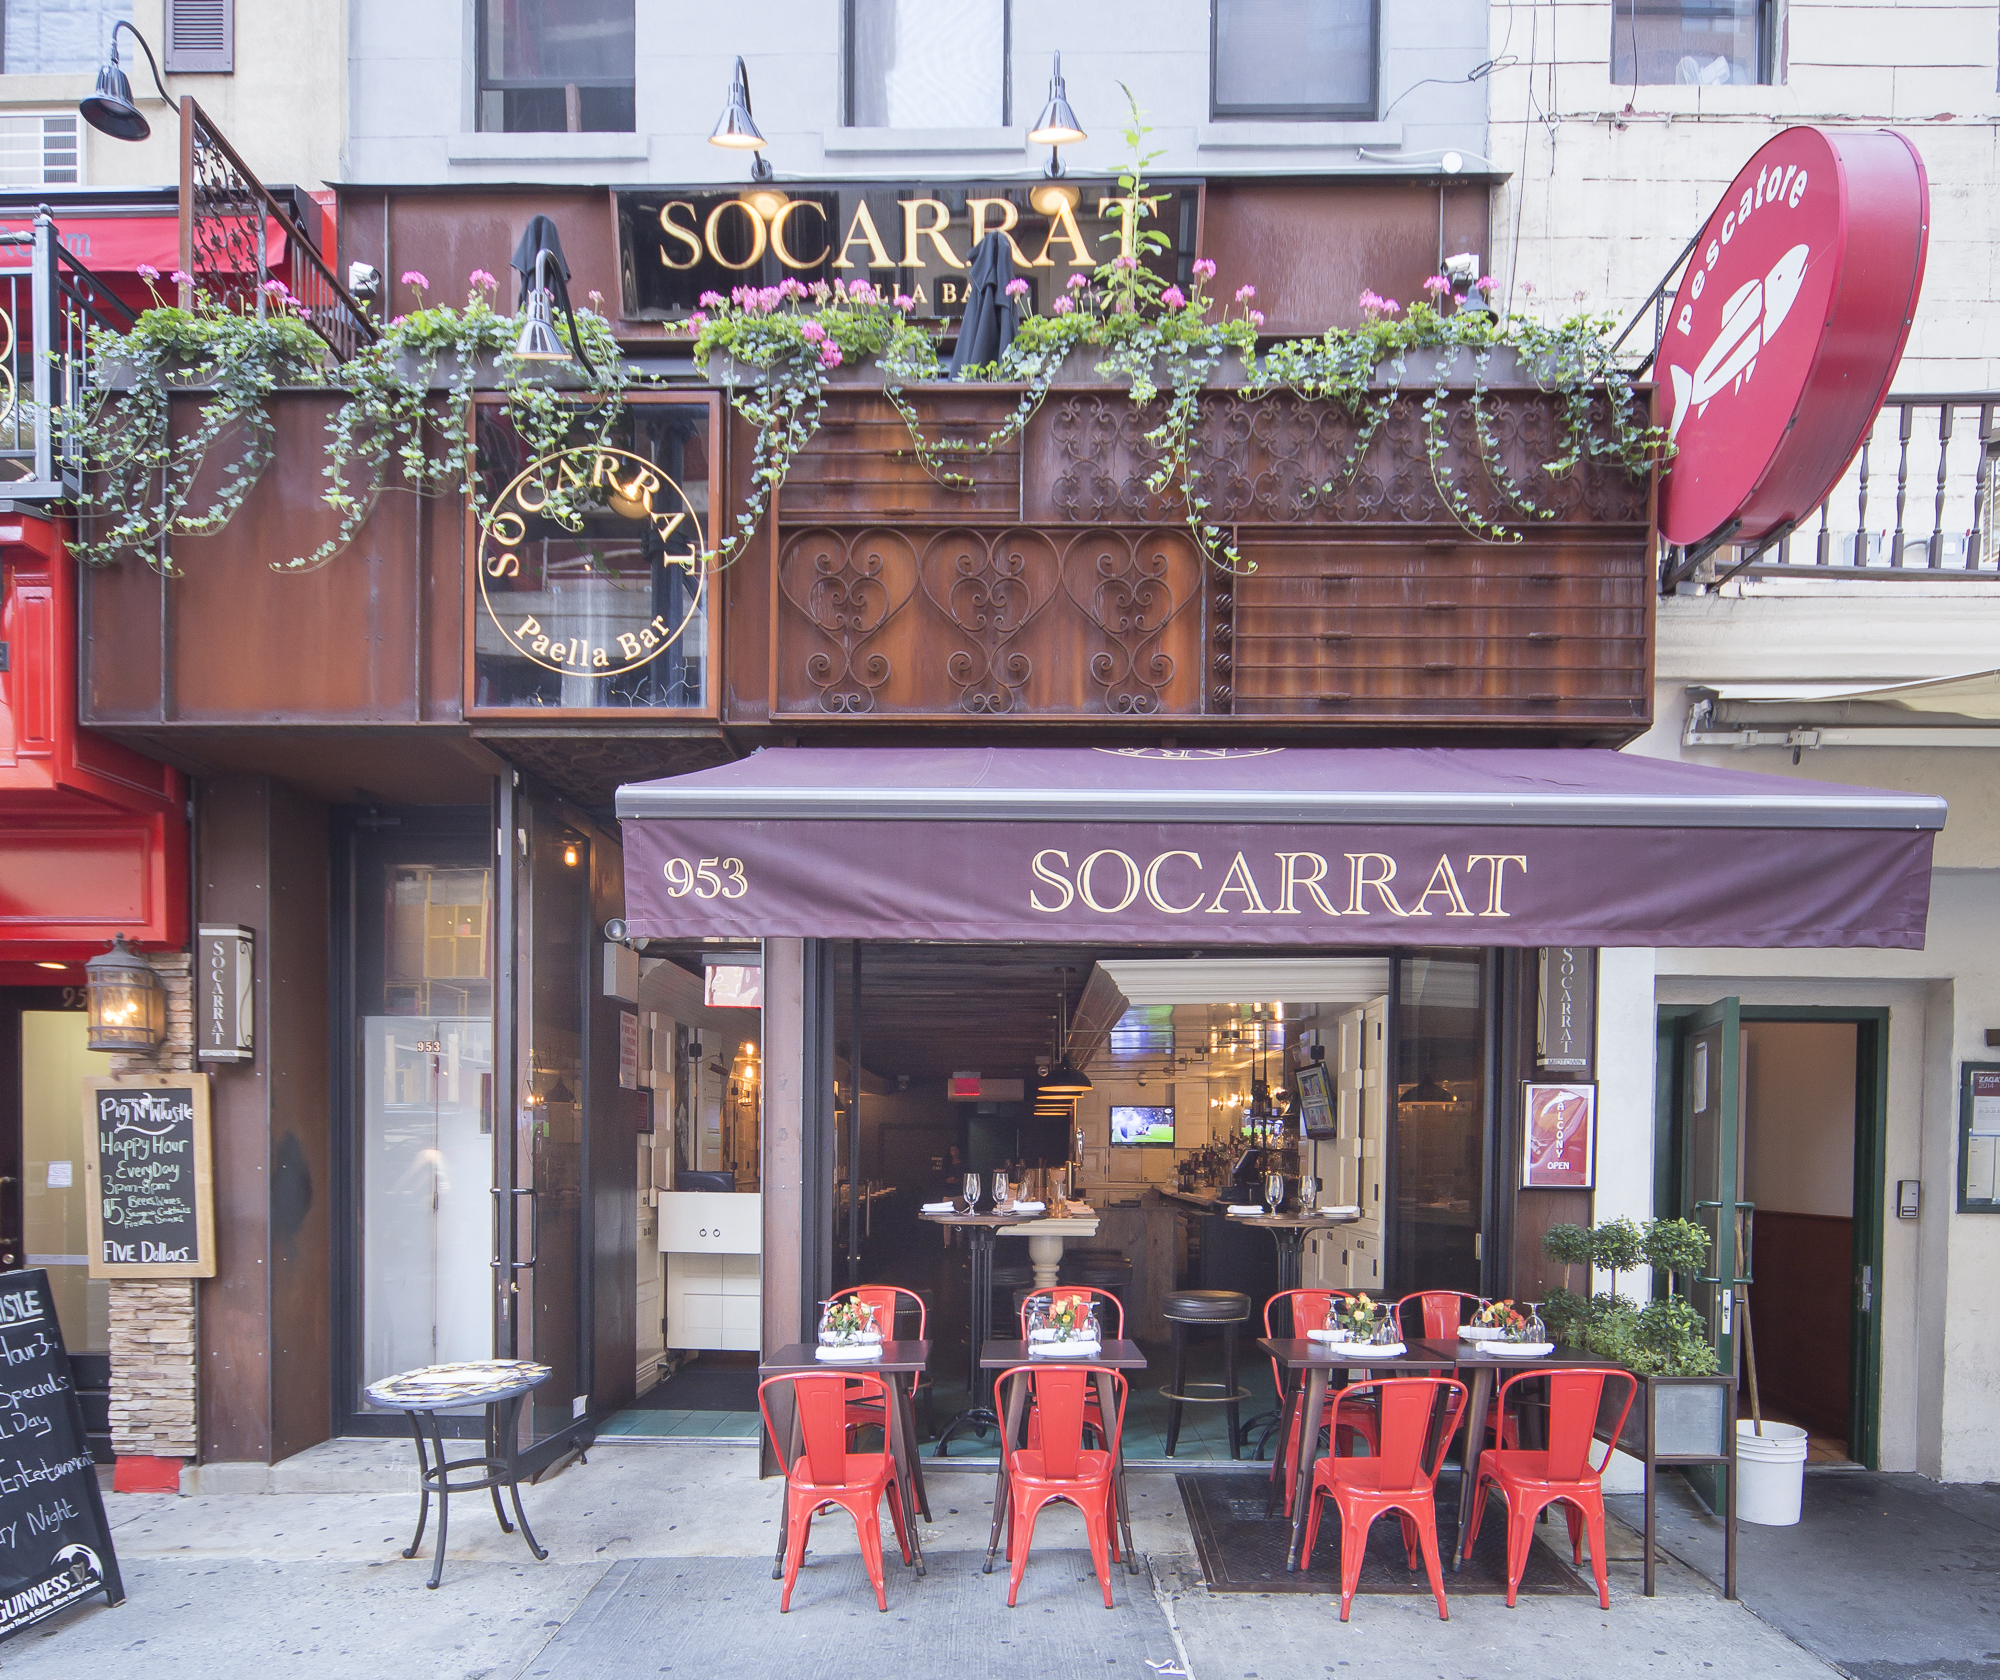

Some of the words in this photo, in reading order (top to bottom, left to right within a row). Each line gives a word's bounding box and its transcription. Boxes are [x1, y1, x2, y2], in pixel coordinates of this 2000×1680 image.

[659, 197, 1158, 271] SOCARRAT
[1677, 164, 1808, 336] pescatore
[487, 454, 697, 577] SOCARRAT
[513, 614, 610, 668] Paella
[616, 614, 670, 661] Bar
[663, 857, 748, 898] 953
[1030, 848, 1528, 917] SOCARRAT
[211, 940, 226, 1045] SOCARRAT
[1560, 947, 1575, 1054] SOCARRAT
[417, 1041, 441, 1052] 953
[100, 1097, 130, 1128] Pig
[1555, 1097, 1565, 1158] ALCONY
[101, 1131, 150, 1160] Happy
[152, 1136, 190, 1155] Hour
[1547, 1161, 1570, 1170] OPEN
[103, 1240, 138, 1262] FIVE
[141, 1240, 190, 1263] Dollars
[0, 1290, 44, 1322] ISTLE
[11, 1411, 53, 1438] Day
[26, 1498, 79, 1536] Night
